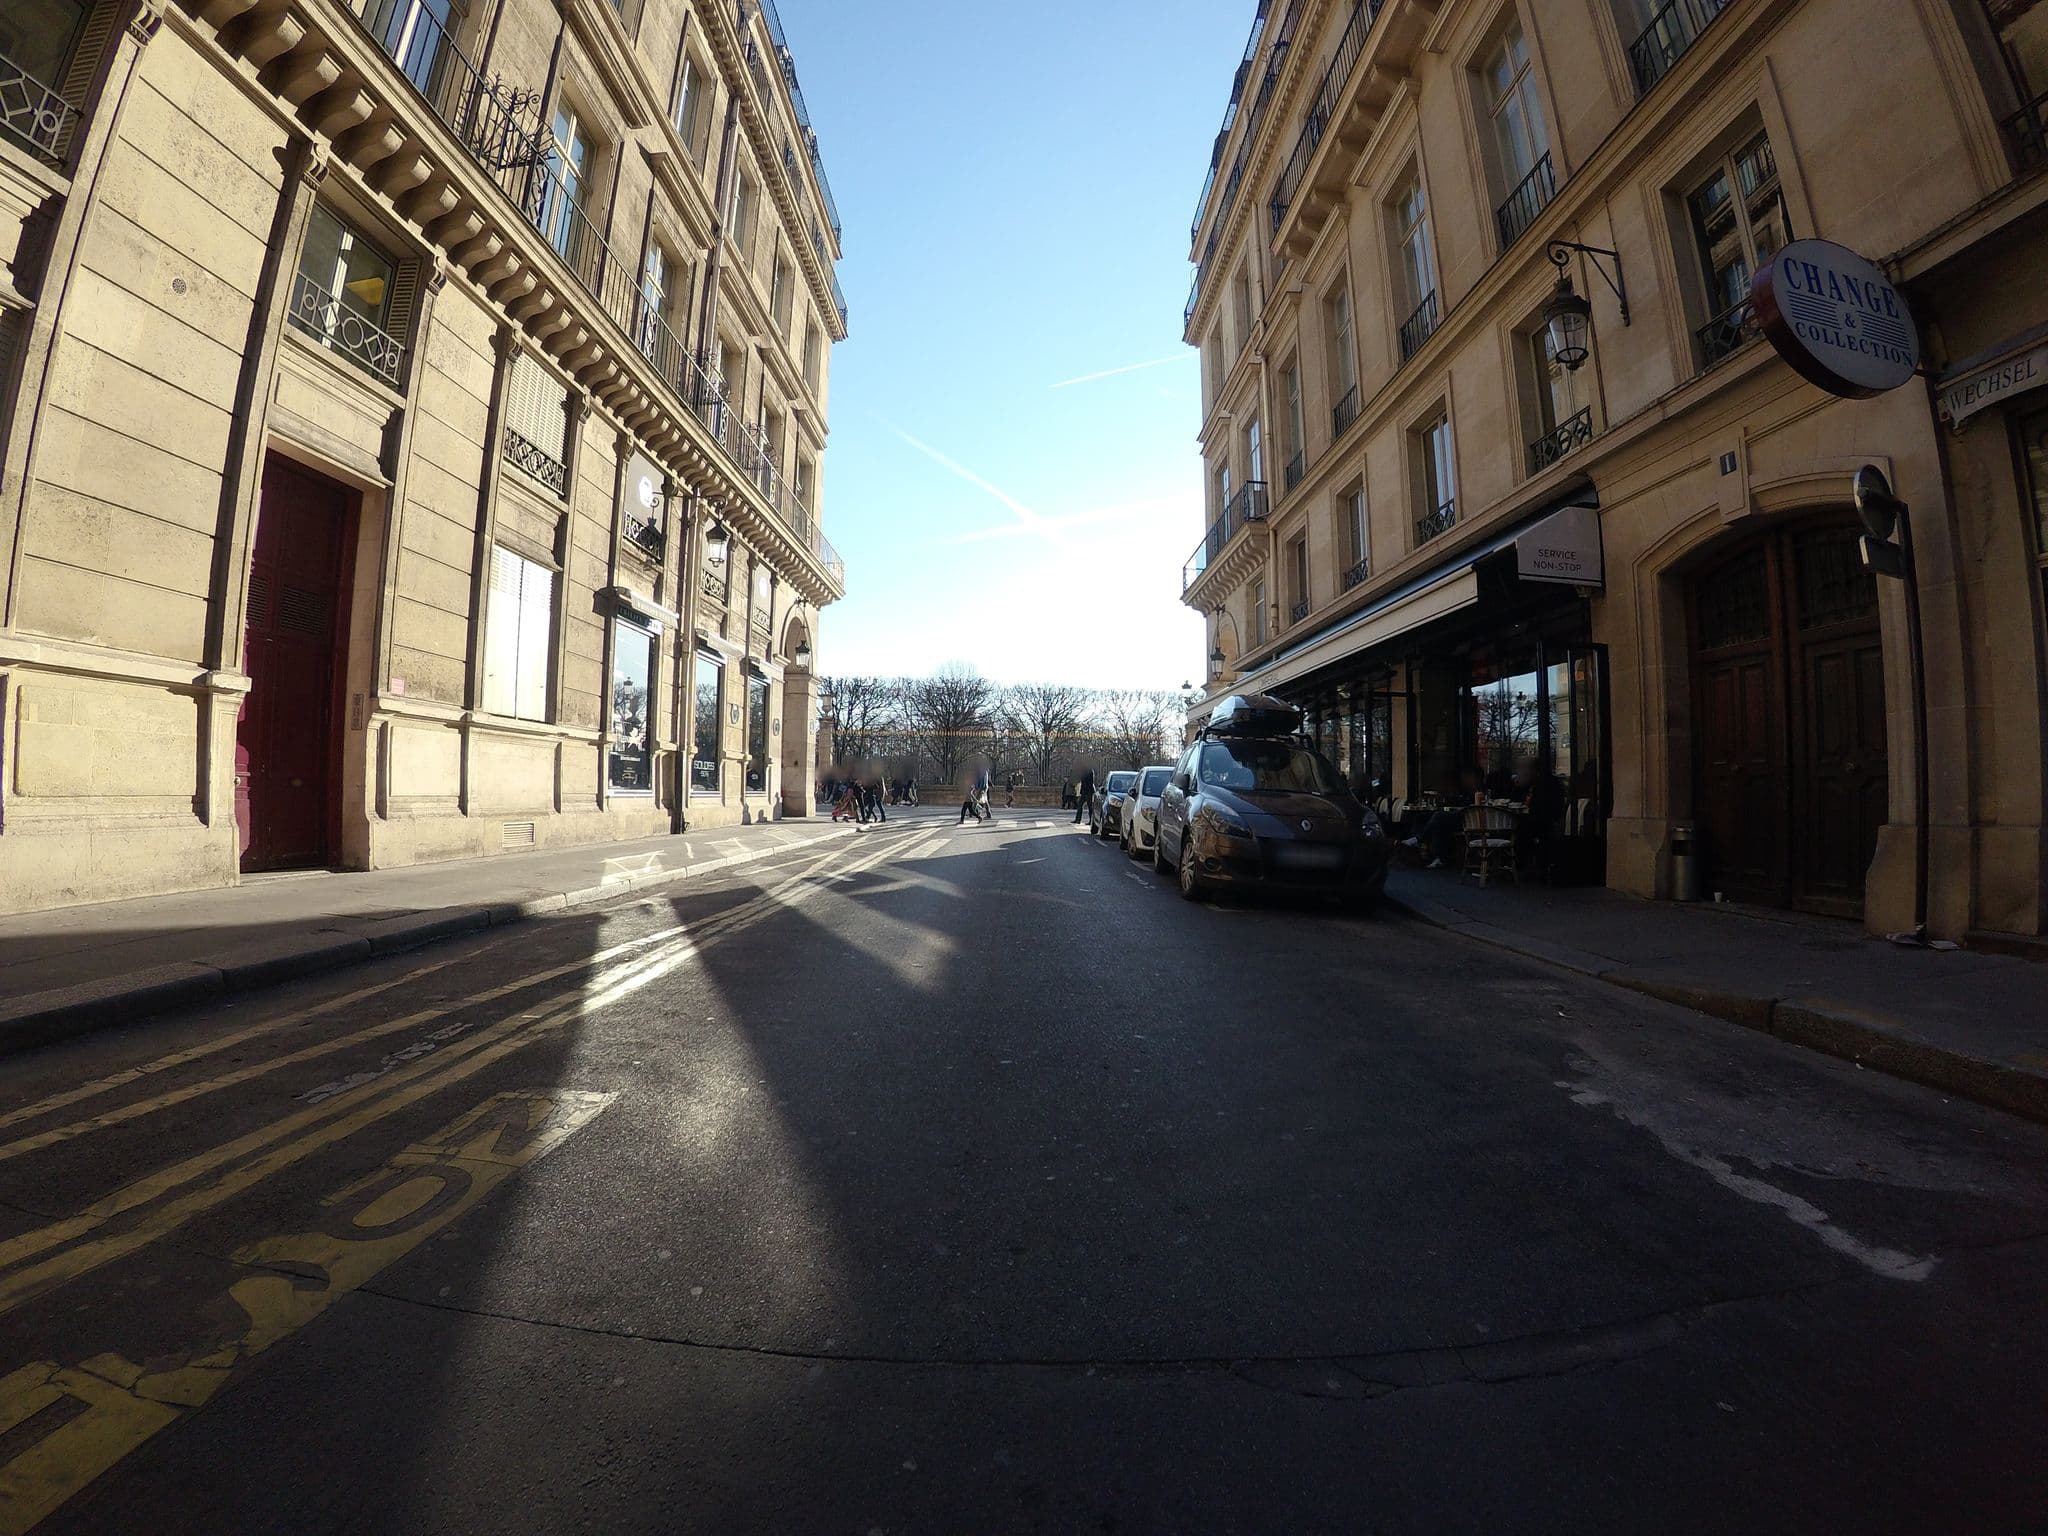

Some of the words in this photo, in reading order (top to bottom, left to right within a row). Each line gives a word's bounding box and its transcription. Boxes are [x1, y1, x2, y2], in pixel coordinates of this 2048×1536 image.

[1783, 256, 1900, 320] CHANGE
[1843, 312, 1857, 328] &
[1795, 321, 1914, 368] COLLECTION
[1950, 358, 2038, 411] WECHSEL
[1533, 560, 1582, 572] NON-STOP
[1538, 549, 1577, 560] SERVICE
